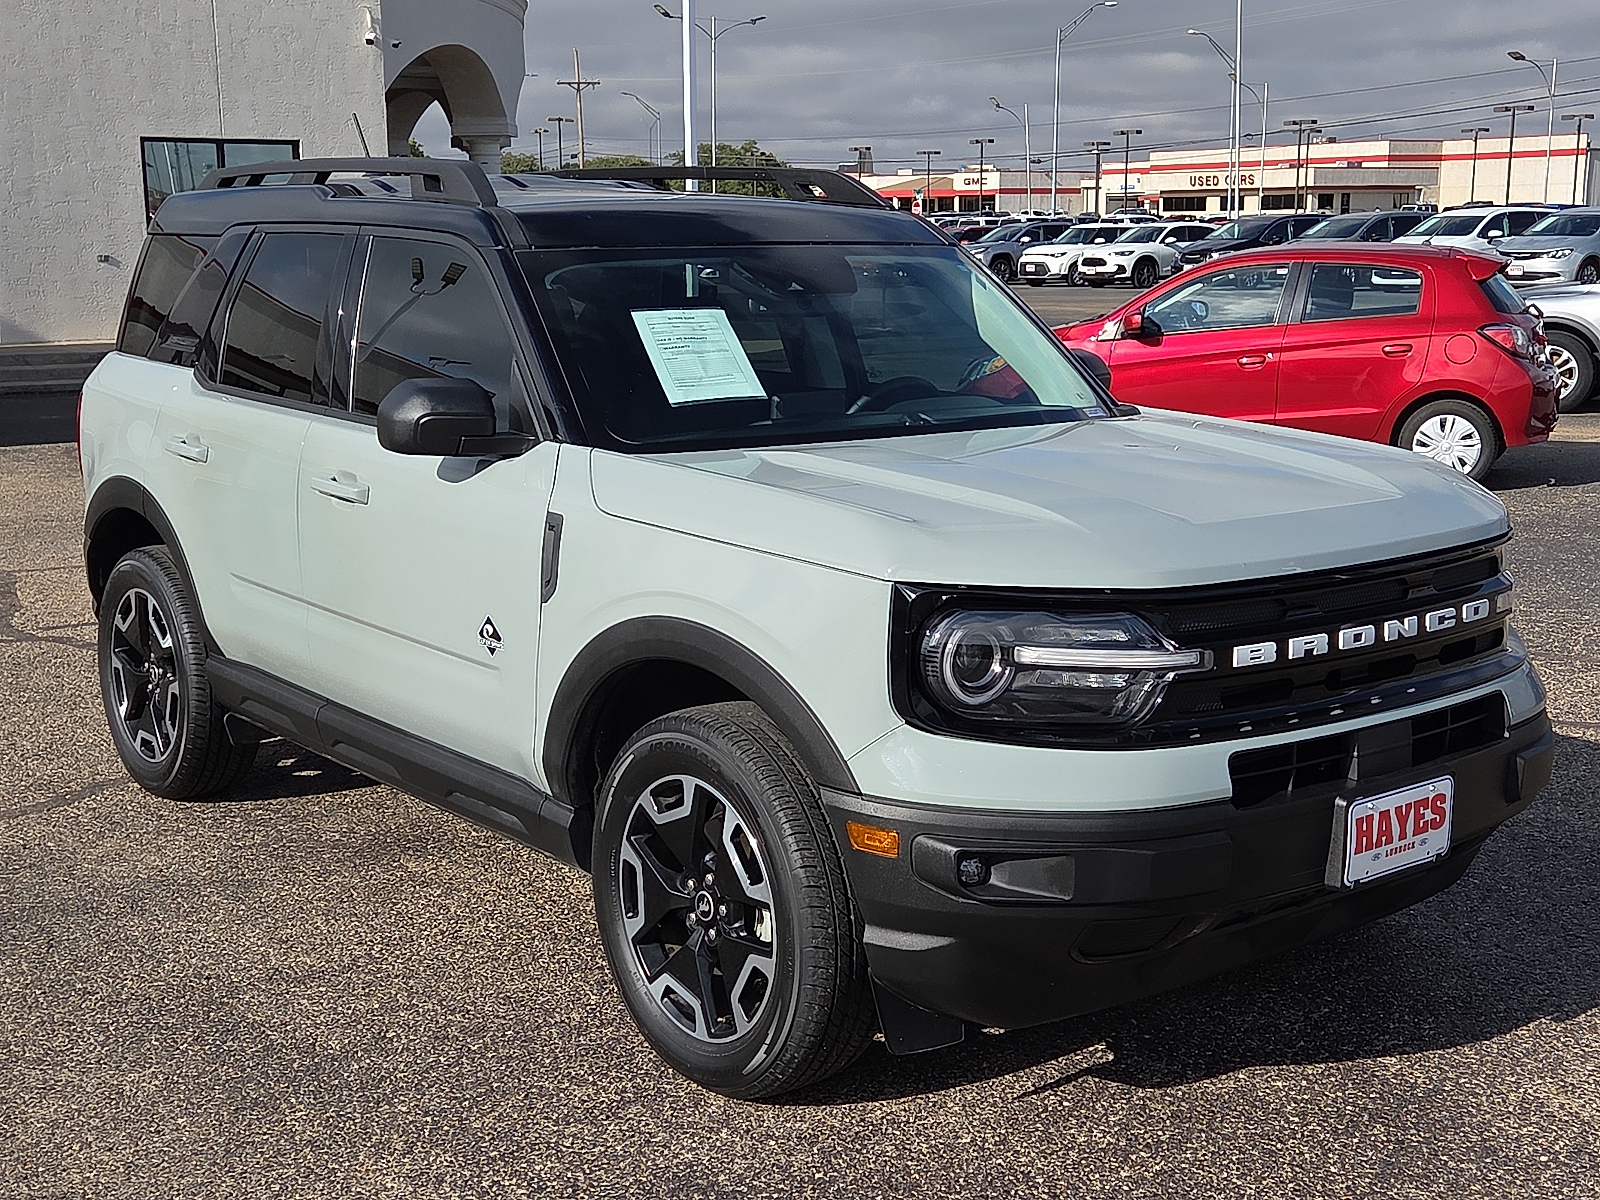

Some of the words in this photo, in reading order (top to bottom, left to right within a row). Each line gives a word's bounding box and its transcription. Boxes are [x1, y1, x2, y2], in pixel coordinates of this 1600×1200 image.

[963, 177, 987, 186] GMC
[1189, 175, 1219, 187] USED
[1232, 598, 1490, 668] BRONCO
[1354, 793, 1447, 856] HAYES
